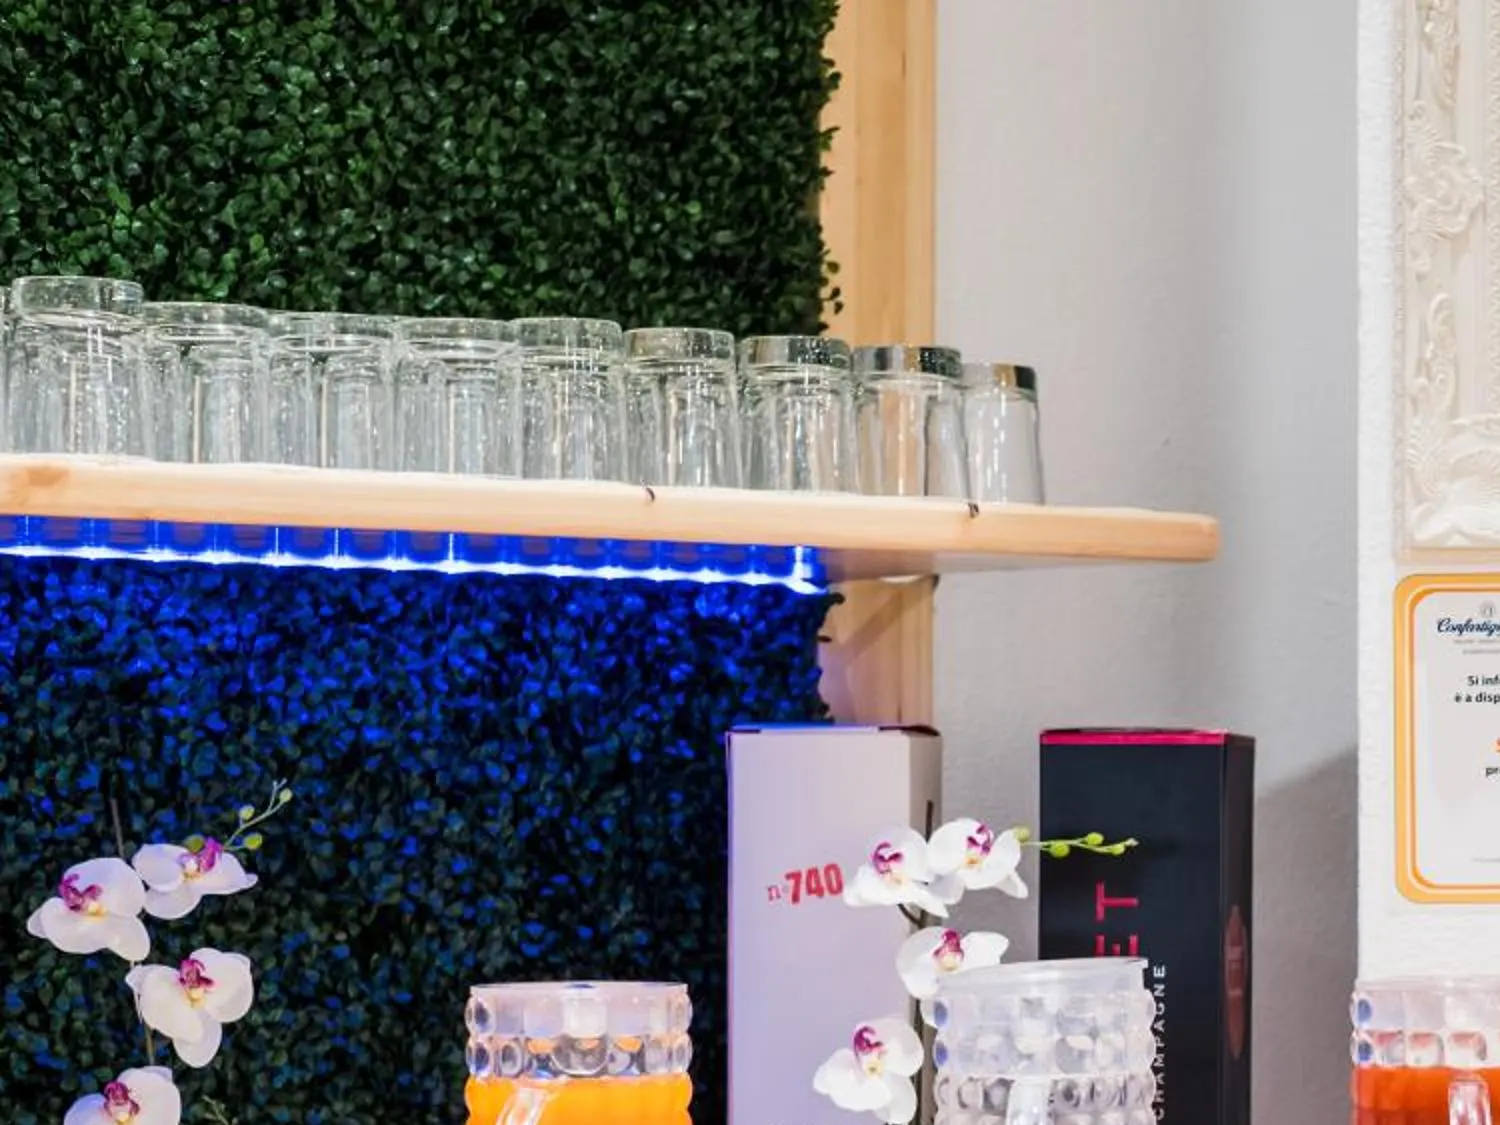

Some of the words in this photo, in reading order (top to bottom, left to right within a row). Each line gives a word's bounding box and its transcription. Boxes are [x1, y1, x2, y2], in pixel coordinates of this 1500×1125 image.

[1467, 675, 1479, 686] Si
[1465, 694, 1472, 702] a
[1153, 963, 1167, 1121] CHAMPAGNE
